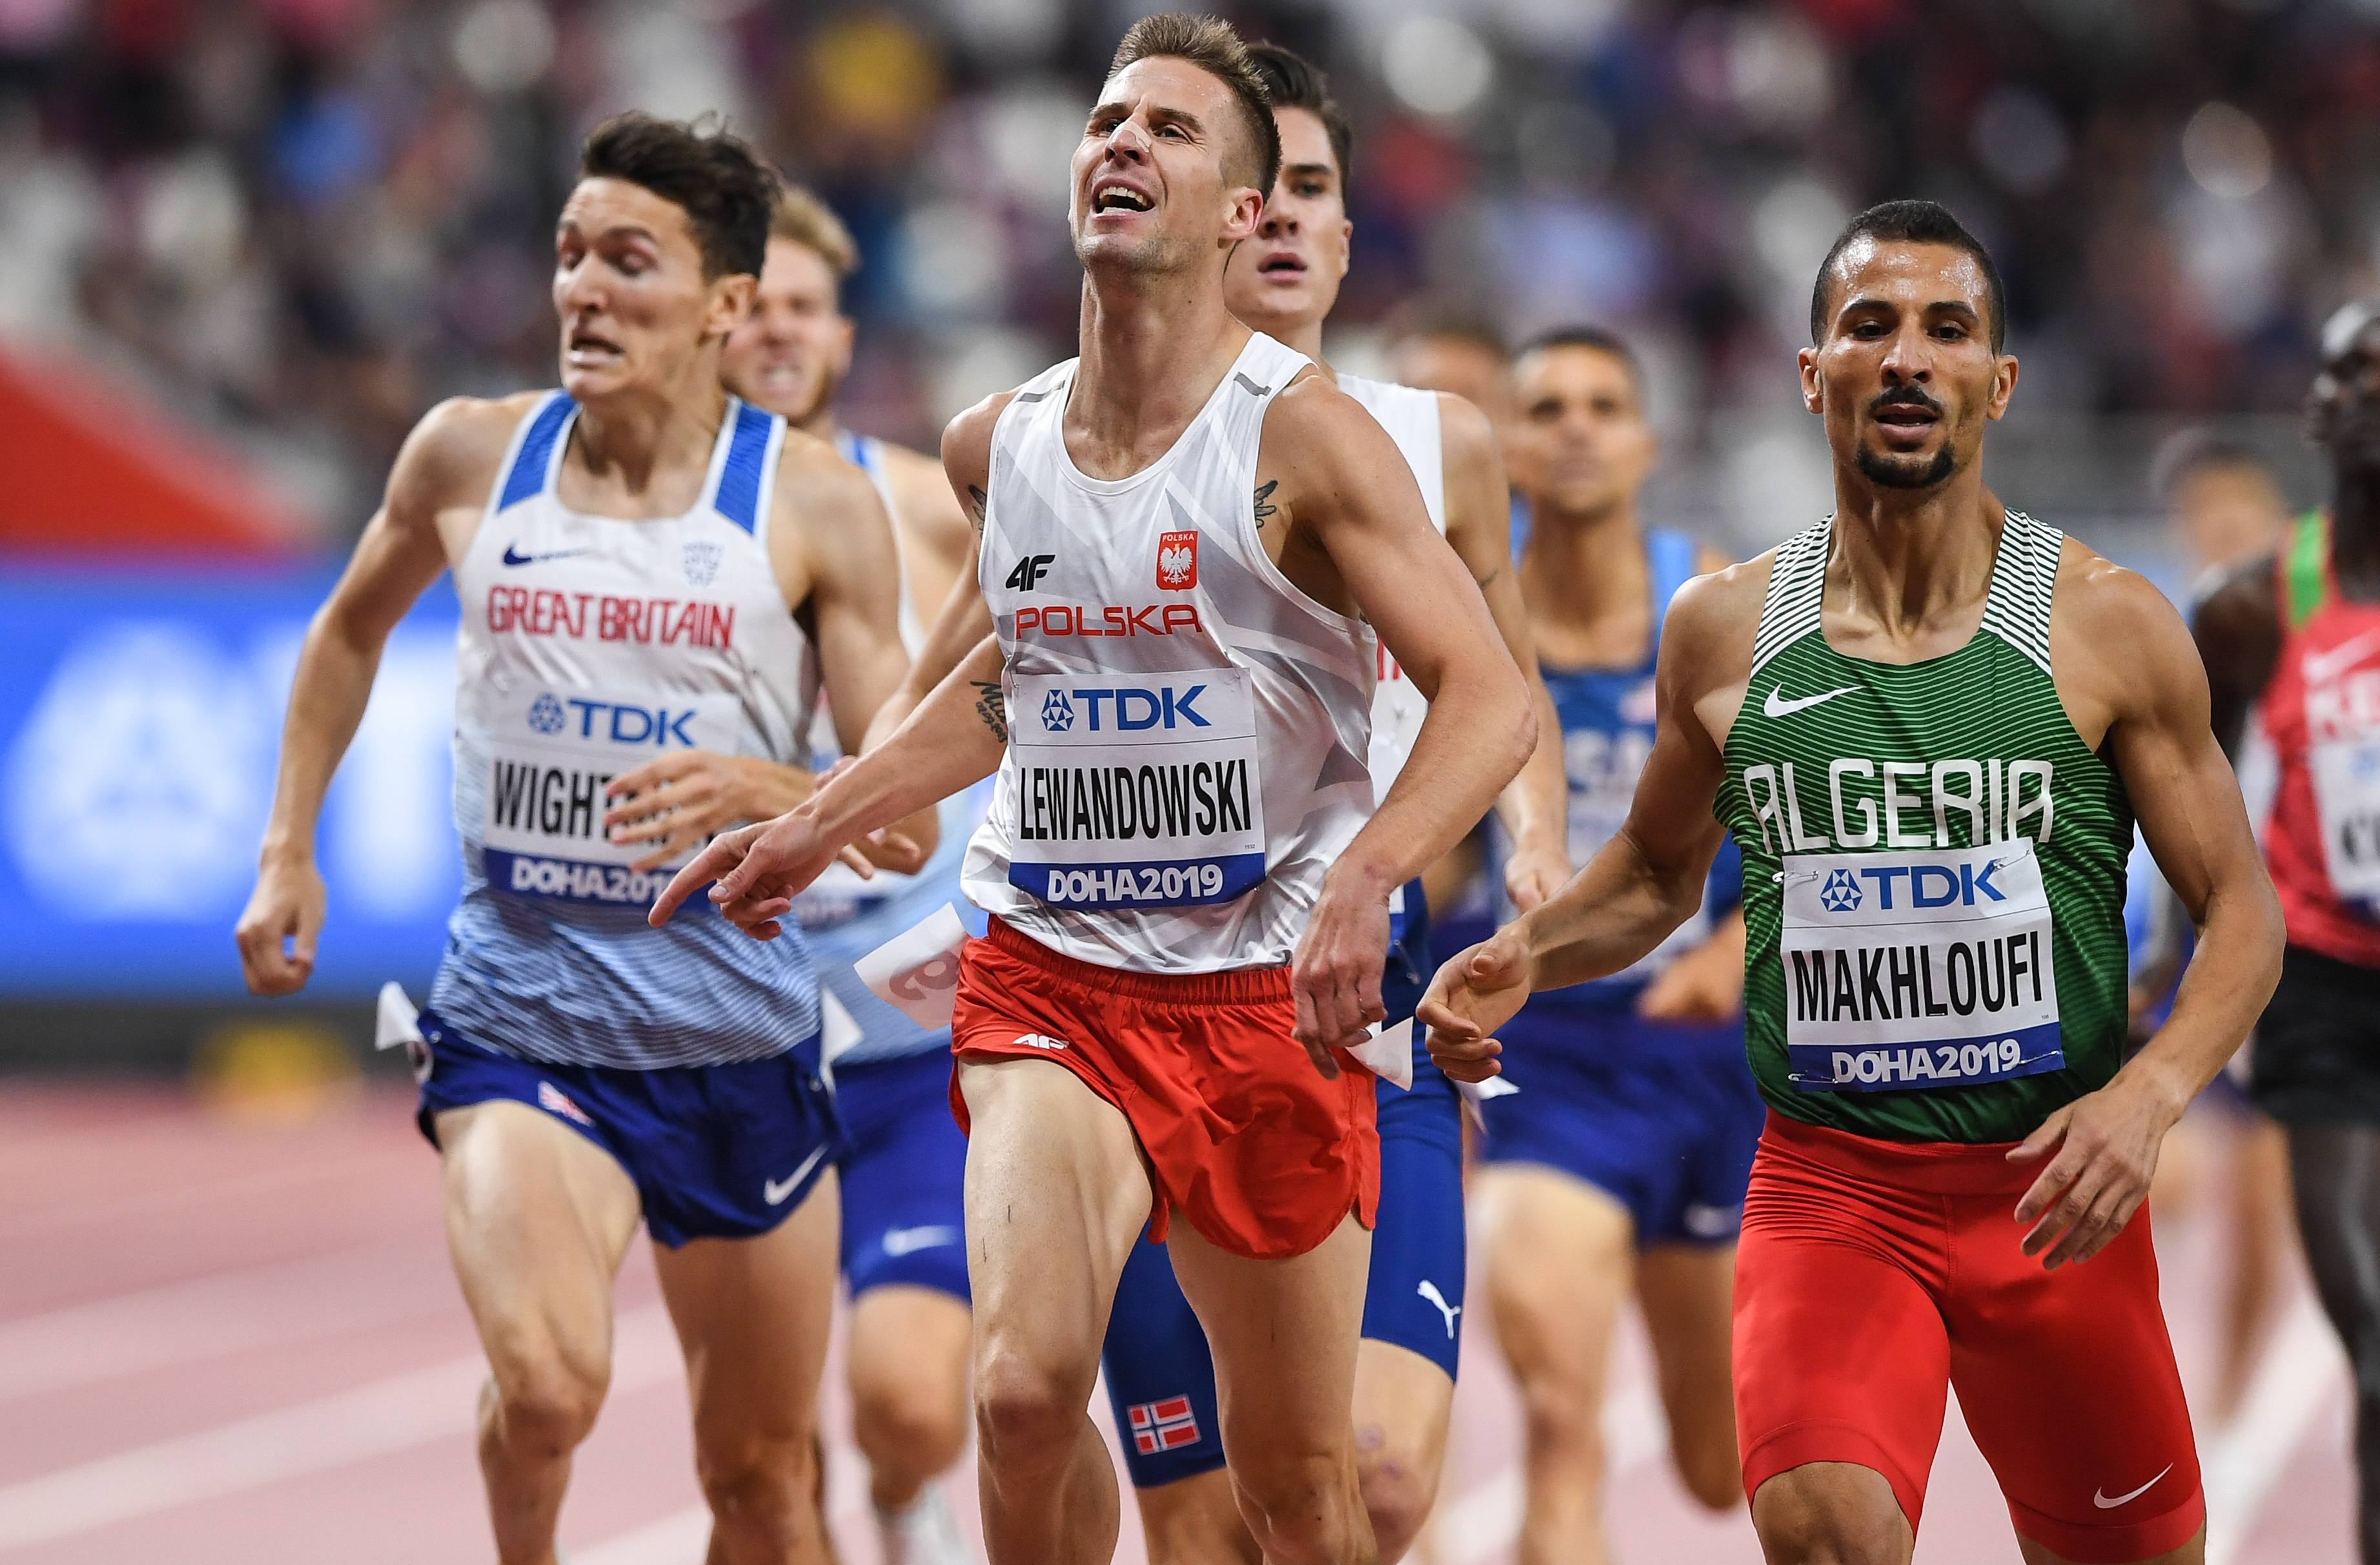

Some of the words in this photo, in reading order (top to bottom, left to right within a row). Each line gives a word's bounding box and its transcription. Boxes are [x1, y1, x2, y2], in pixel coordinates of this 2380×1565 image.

[1162, 533, 1195, 542] POLSKA
[1005, 554, 1056, 592] 4F
[487, 584, 595, 639] GREAT
[598, 595, 736, 651] BRITAIN
[1016, 604, 1203, 639] POLSKA
[568, 698, 697, 747] TDK
[1072, 684, 1212, 731] TDK
[1020, 759, 1251, 840] LEWANDOWSKI
[1744, 758, 2054, 855] ALGERIA
[511, 856, 673, 904] DOHA201
[1047, 864, 1224, 902] DOHA2019
[1860, 859, 2007, 910] TDK
[1790, 931, 2042, 1022] MAKHLOUFI
[1831, 1038, 2022, 1084] DOHA2019
